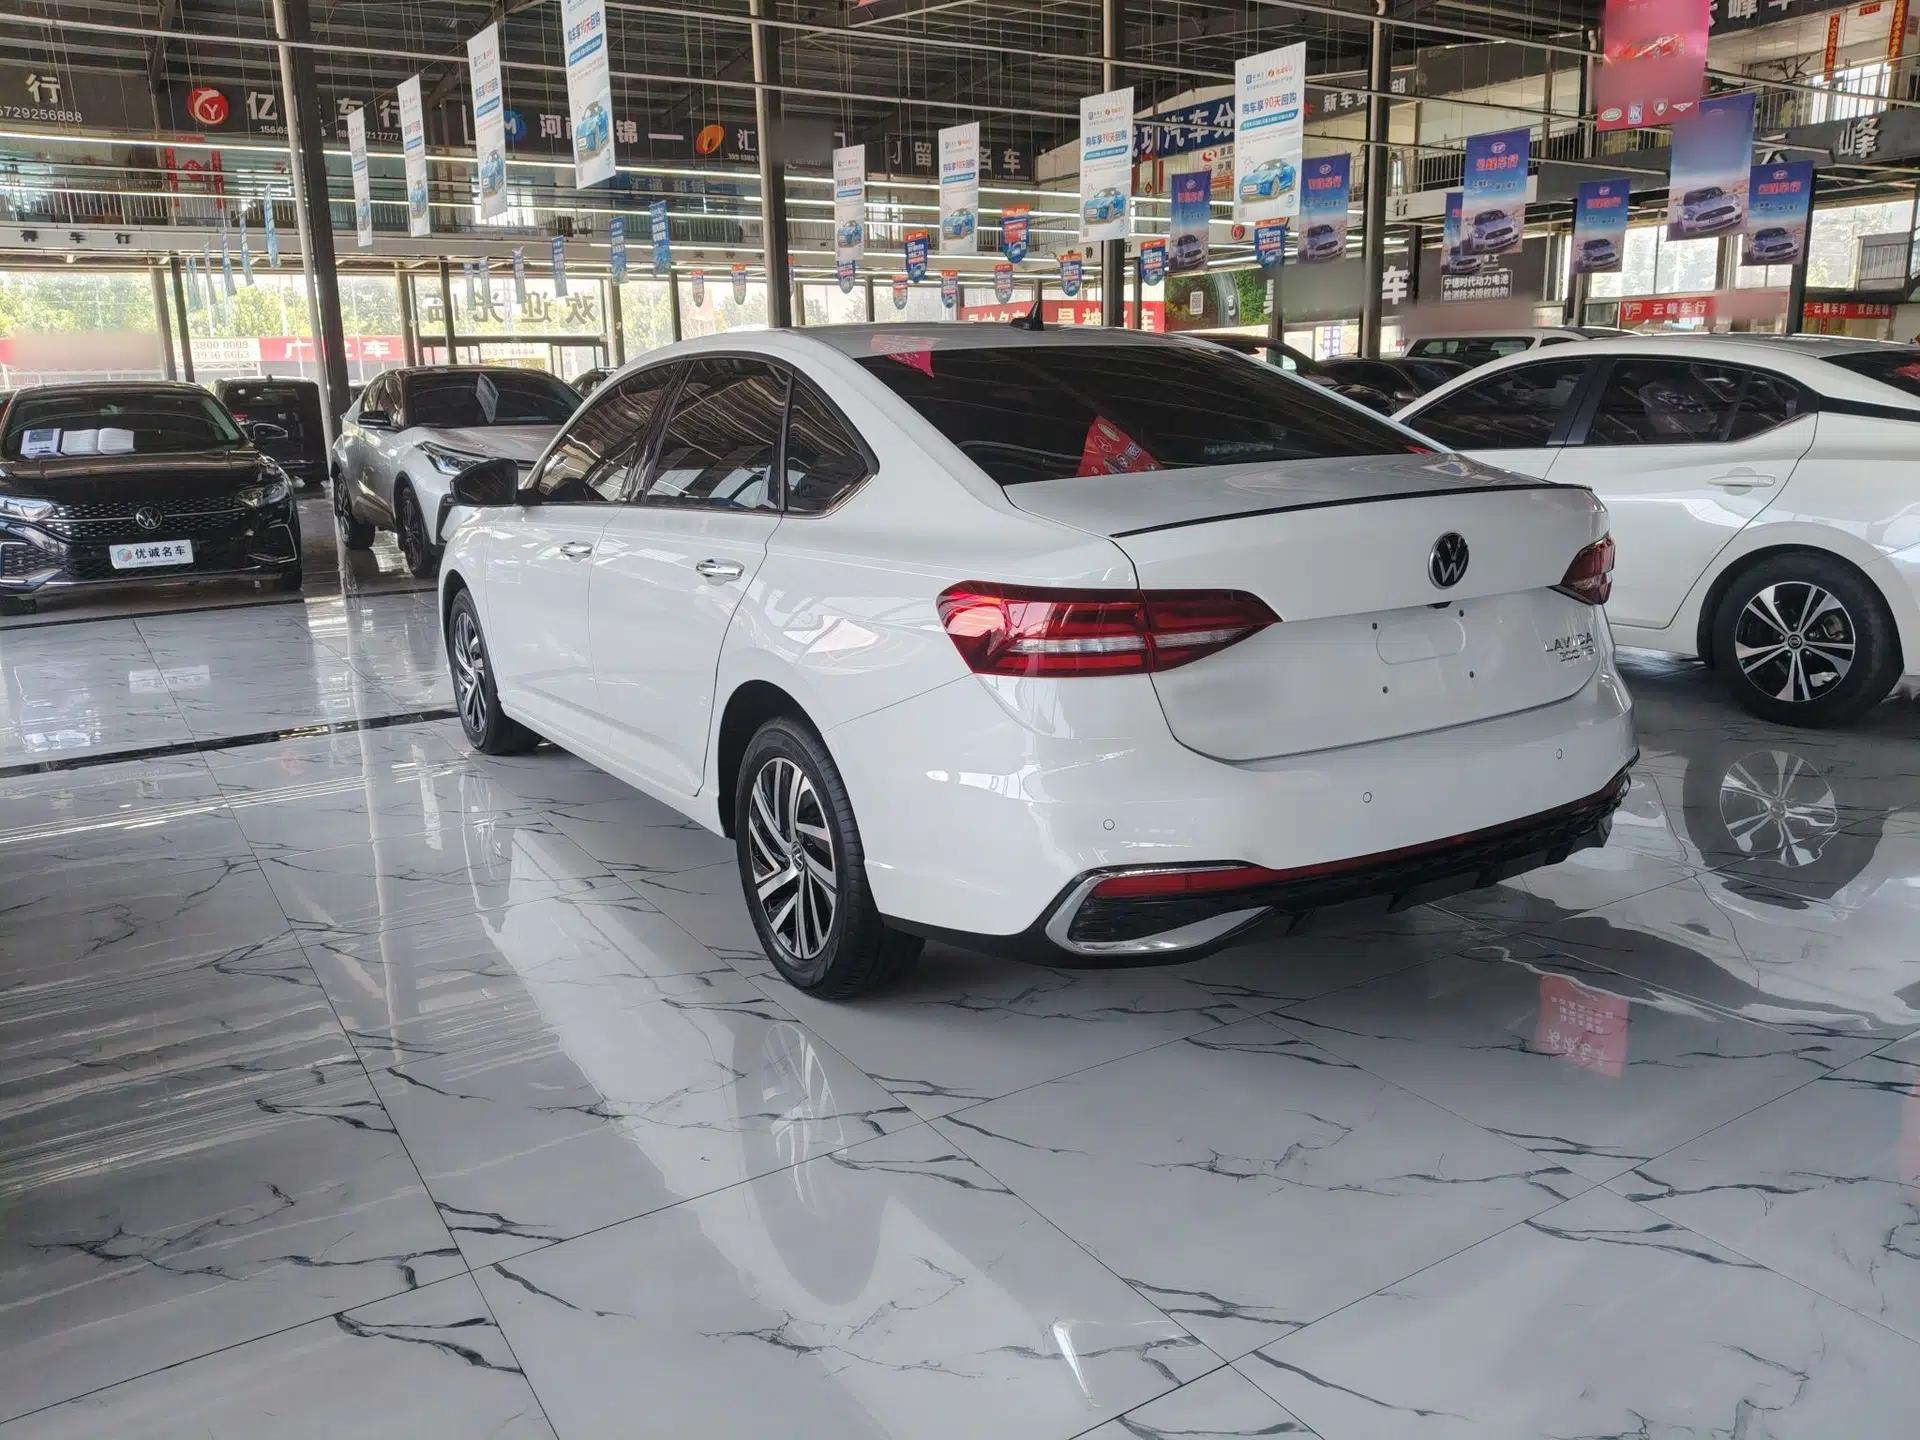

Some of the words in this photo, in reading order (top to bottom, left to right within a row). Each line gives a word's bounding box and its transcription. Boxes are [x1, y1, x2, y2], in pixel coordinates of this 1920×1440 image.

[25, 73, 61, 103] 行
[1241, 92, 1297, 115] 购车享90天回购
[1652, 301, 1707, 316] 云峰车行
[134, 545, 186, 559] 优诚名车
[1544, 632, 1594, 652] LAVIDA
